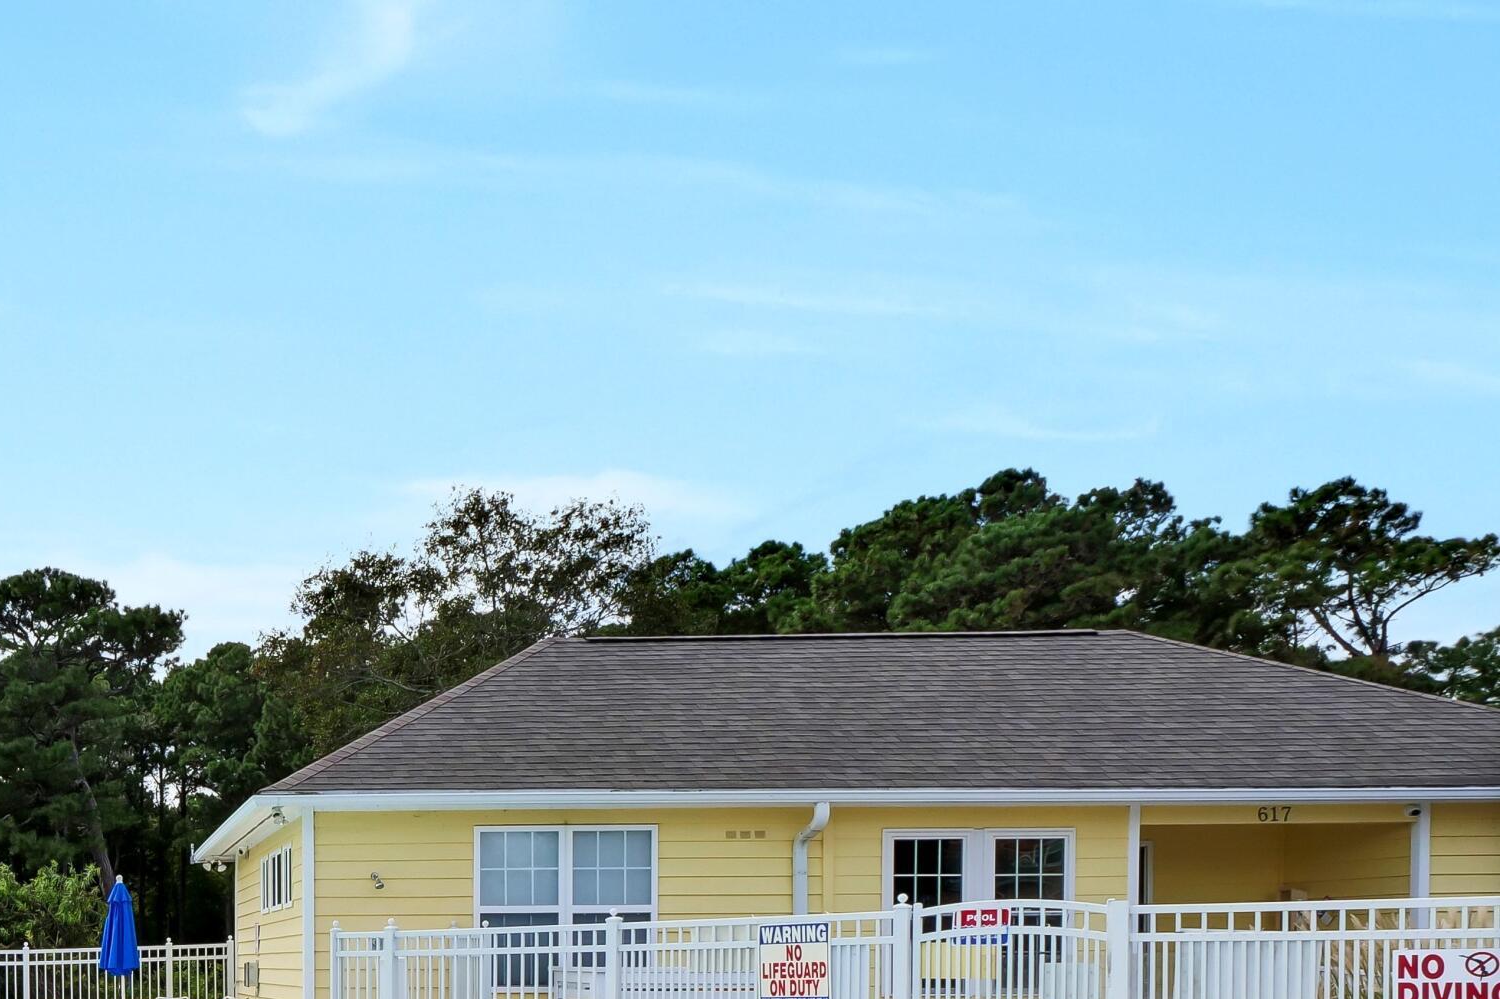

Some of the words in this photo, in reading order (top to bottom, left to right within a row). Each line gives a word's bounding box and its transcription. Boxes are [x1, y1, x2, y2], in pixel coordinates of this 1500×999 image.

[1258, 806, 1292, 822] 617
[761, 924, 827, 944] WARNING
[786, 944, 803, 962] NO
[762, 961, 827, 979] LIFEGUARD
[1398, 954, 1445, 979] NO
[770, 980, 786, 996] ON
[790, 979, 820, 996] DUTY
